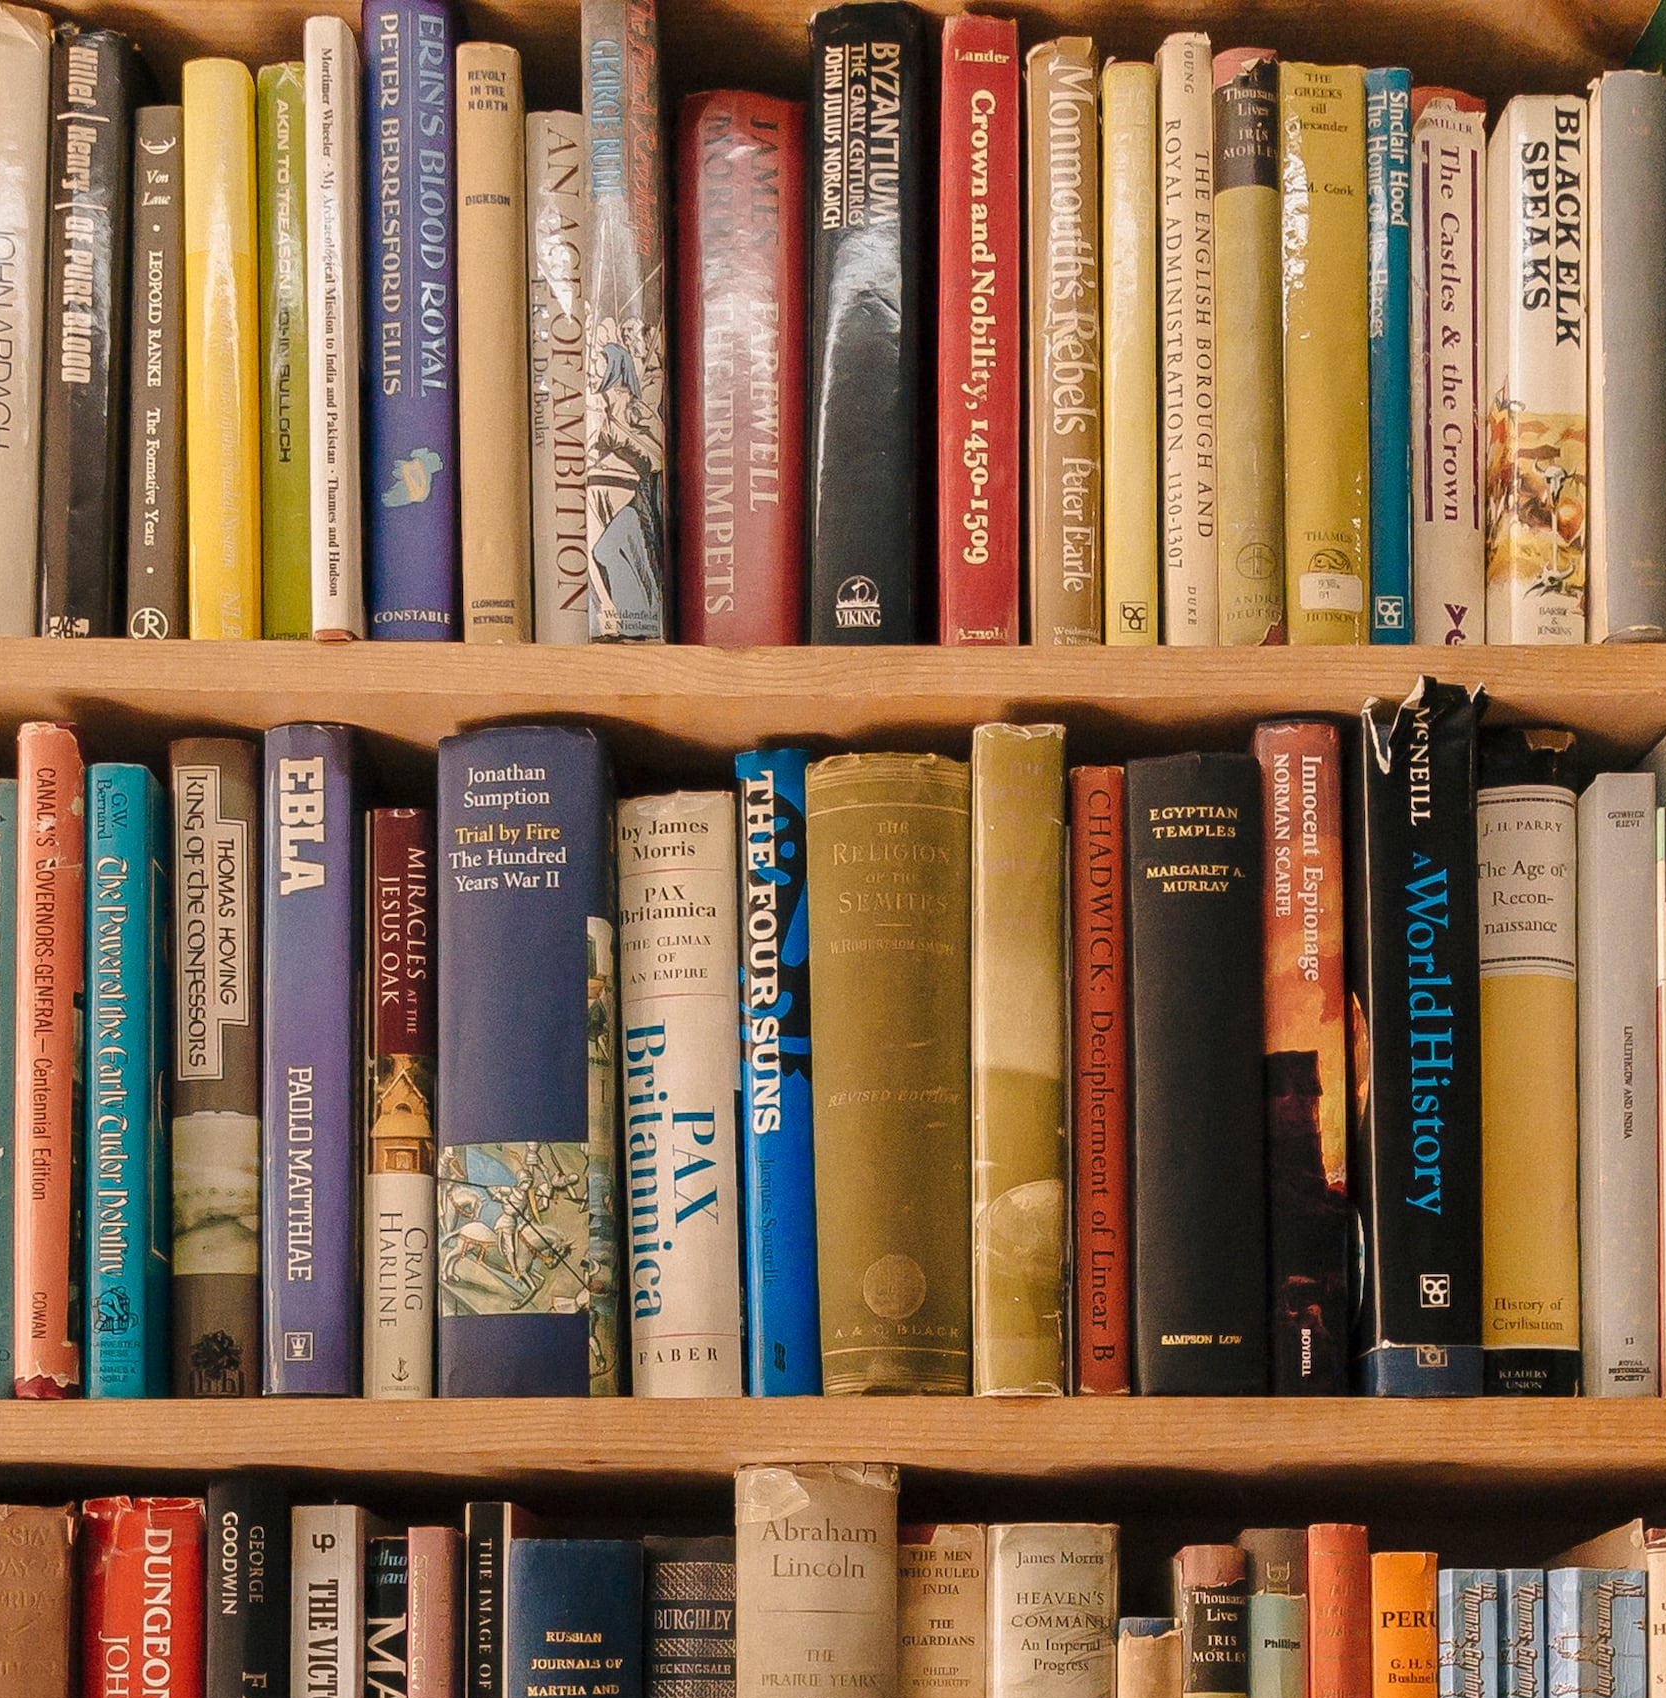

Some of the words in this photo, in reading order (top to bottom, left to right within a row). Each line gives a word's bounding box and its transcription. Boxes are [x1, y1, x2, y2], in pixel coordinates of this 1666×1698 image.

[954, 48, 1010, 63] Lander
[970, 90, 997, 197] Crown
[1439, 146, 1461, 199] The
[1554, 107, 1583, 249] BLACK
[967, 201, 998, 262] and
[1521, 143, 1549, 311] SPEAKS
[1441, 209, 1463, 314] Castles
[1555, 260, 1581, 347] ELK
[963, 268, 998, 410] Nobility,
[1441, 325, 1461, 350] &
[1441, 362, 1463, 410] the
[1441, 420, 1461, 523] Crown
[836, 610, 881, 626] VIKING
[464, 788, 550, 808] Sumption
[466, 765, 546, 784] Jonathan
[280, 758, 325, 894] EBLA
[456, 824, 495, 842] Trial
[500, 824, 521, 845] by
[525, 824, 560, 842] Fire
[1414, 854, 1430, 869] A
[1405, 869, 1453, 1020] World
[1405, 1026, 1453, 1216] History
[672, 1106, 717, 1230] PAX
[638, 1347, 720, 1365] FABER
[763, 1518, 877, 1545] Abraham
[770, 1554, 865, 1580] Lincoln
